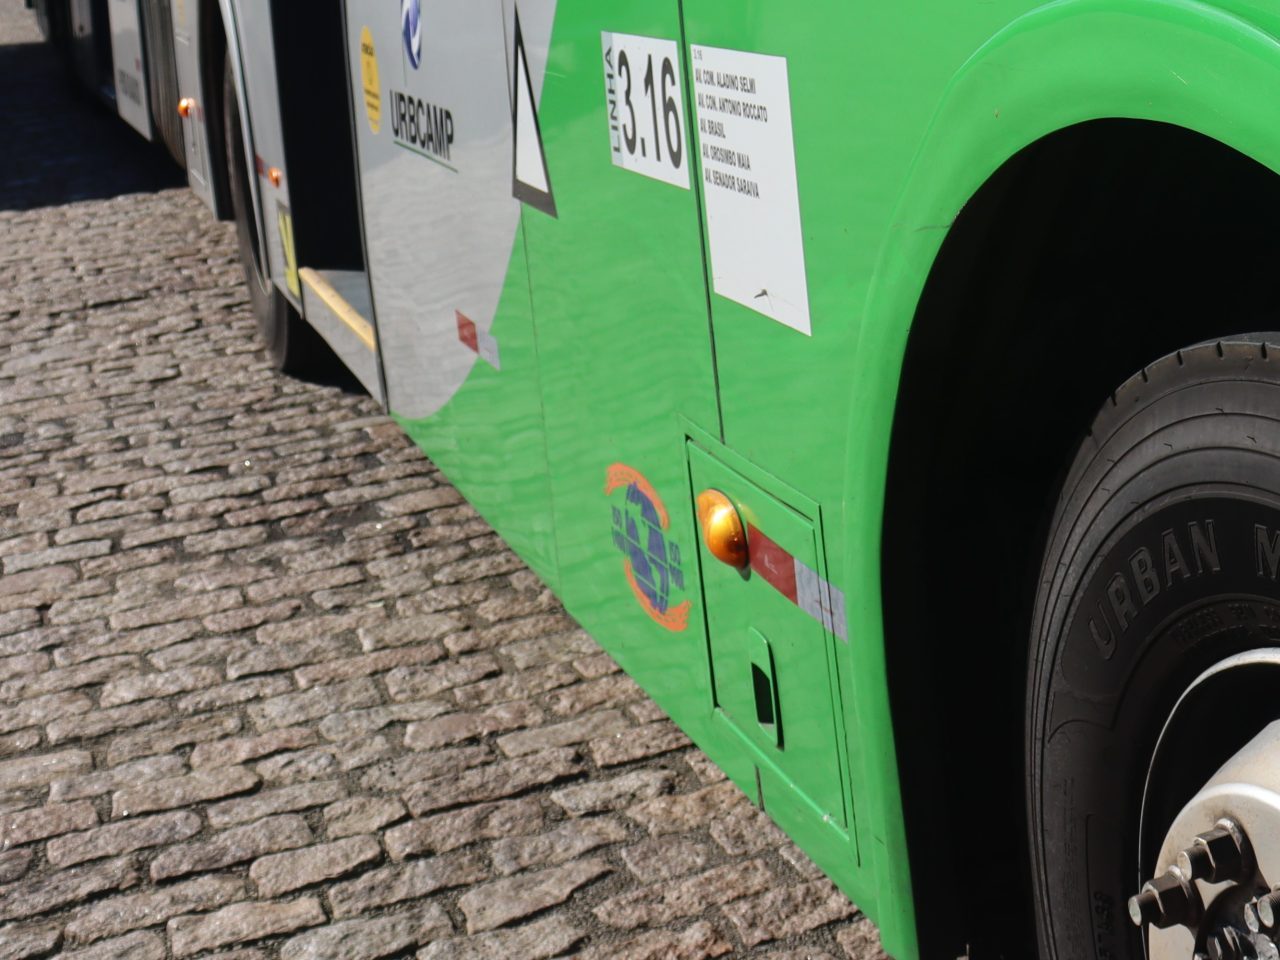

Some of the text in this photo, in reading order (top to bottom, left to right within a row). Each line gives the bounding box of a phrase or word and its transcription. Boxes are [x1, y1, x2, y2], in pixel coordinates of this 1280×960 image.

[716, 72, 738, 91] ALADINO
[739, 76, 756, 94] SELMI
[605, 46, 621, 153] LINHA
[618, 49, 682, 169] 3.16
[718, 97, 742, 117] ANTONIO
[742, 102, 768, 122] ROCCATO
[389, 89, 454, 160] URBCAMP
[707, 120, 726, 139] BRASIL
[737, 152, 751, 171] MAIA
[712, 170, 737, 192] SENADOR
[737, 177, 760, 199] SARAIVA
[1088, 519, 1222, 660] URBAN
